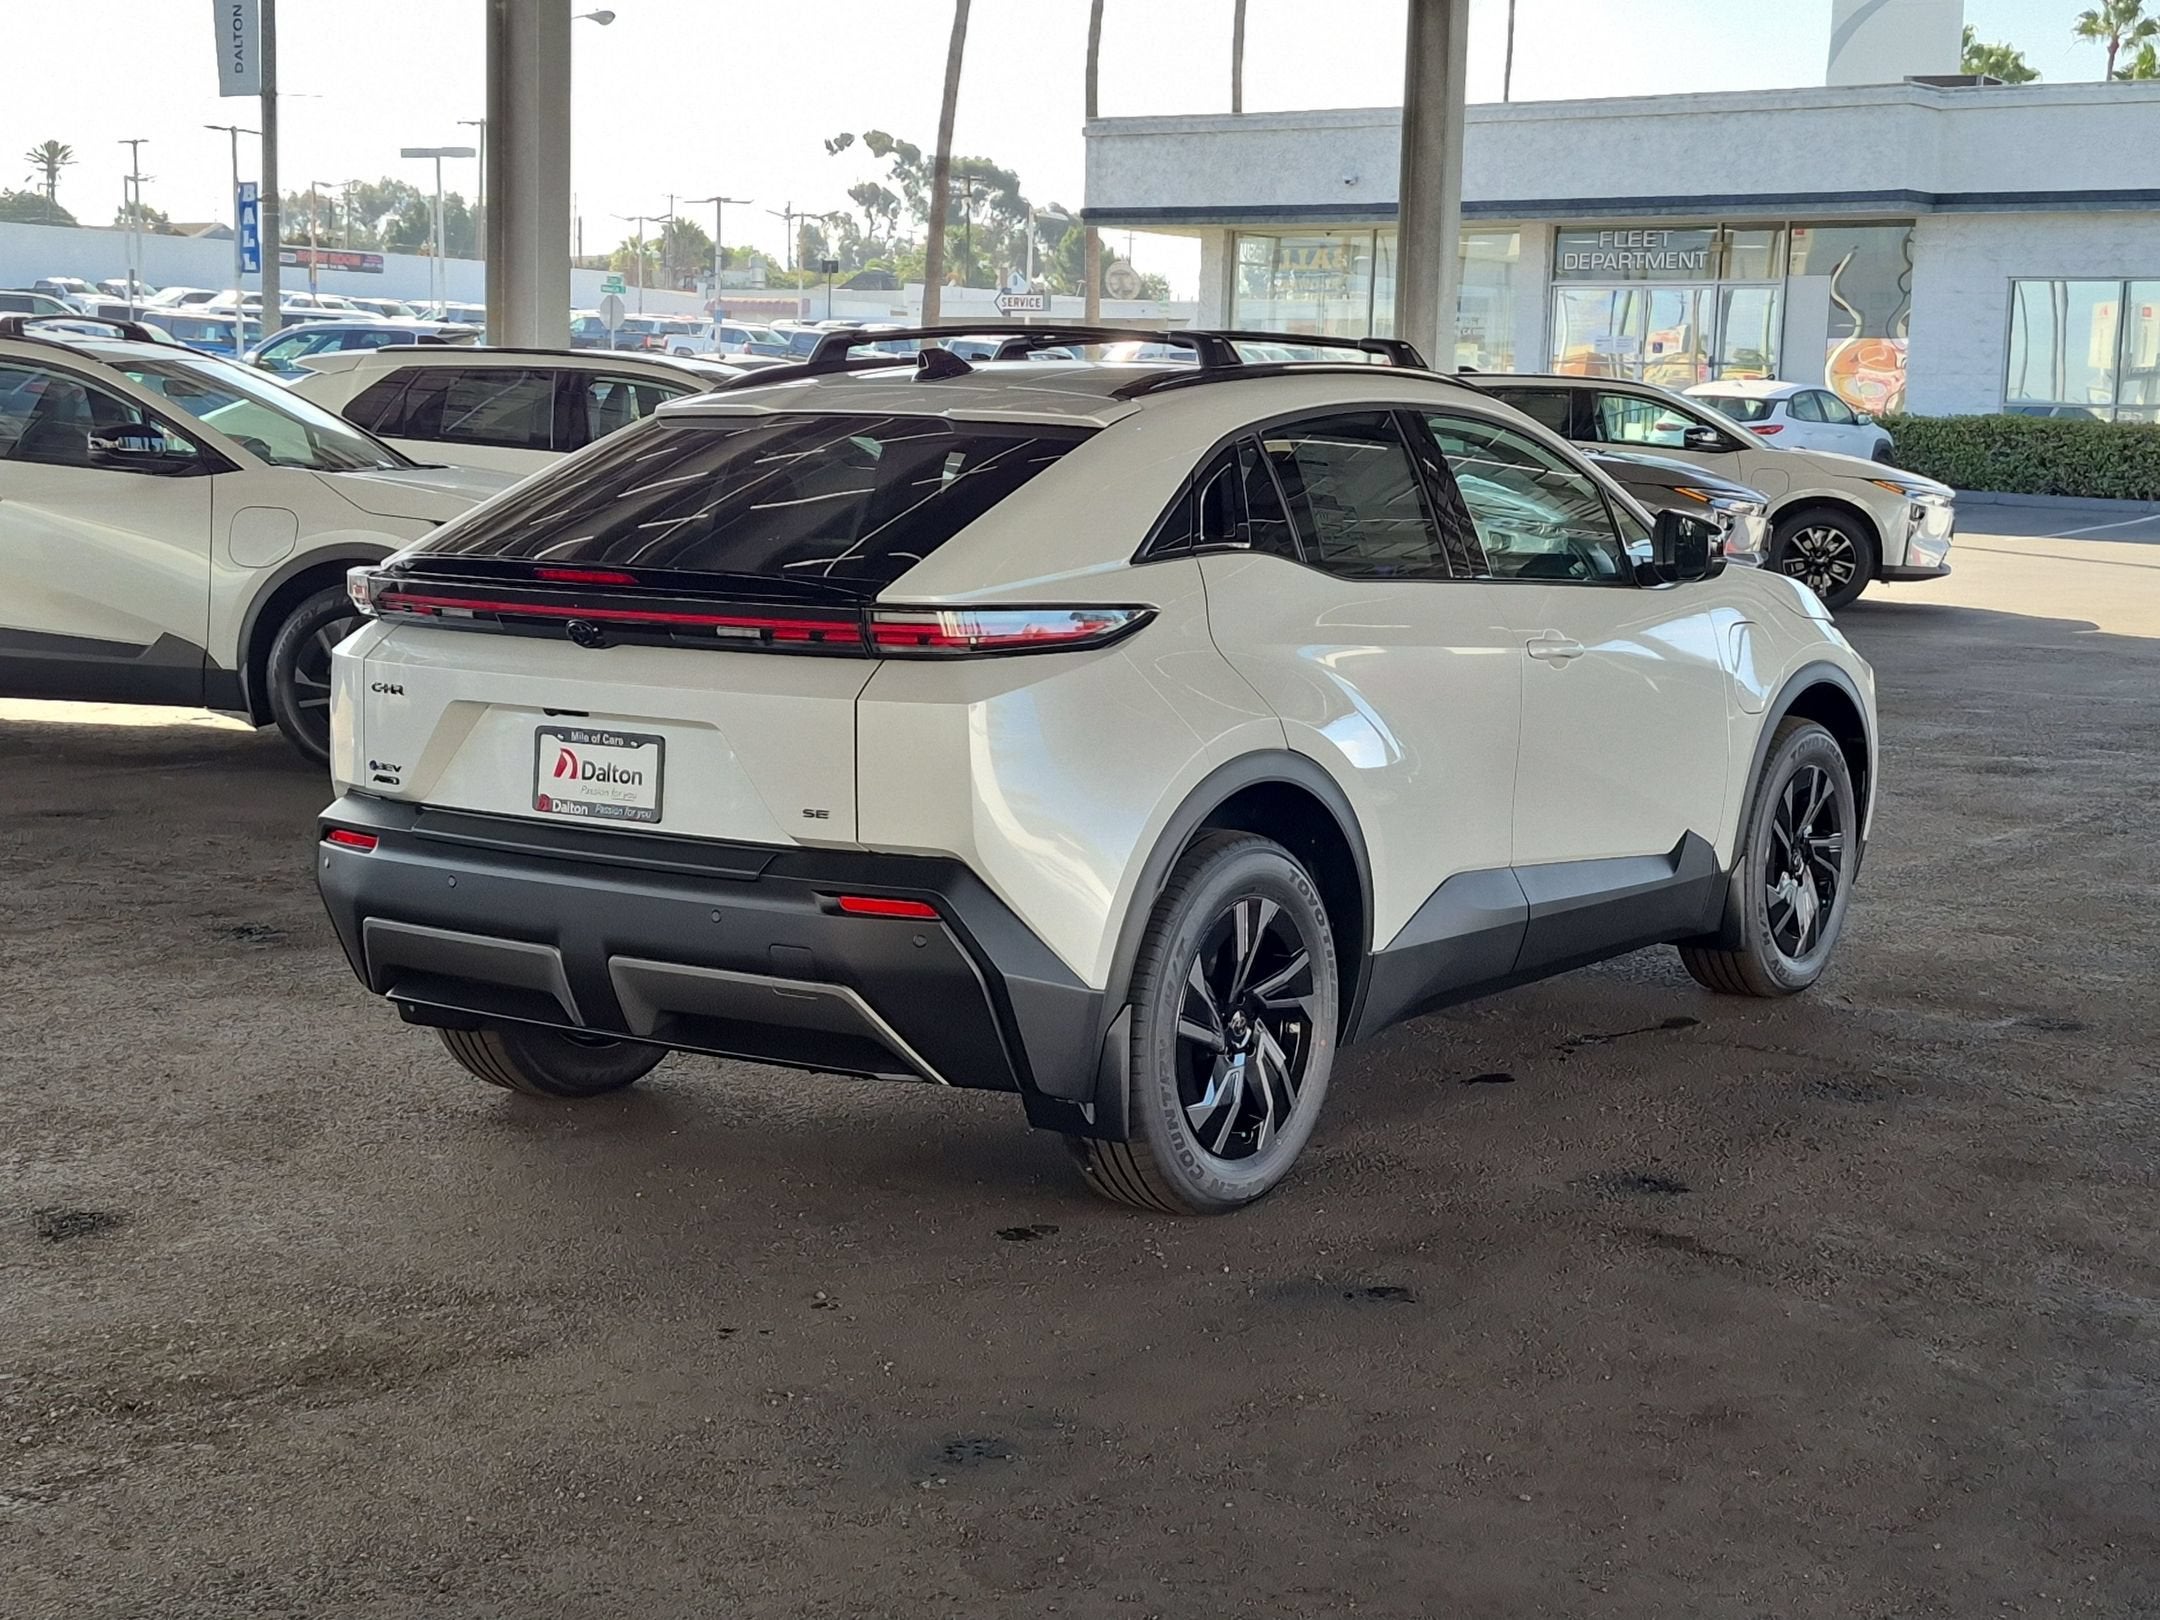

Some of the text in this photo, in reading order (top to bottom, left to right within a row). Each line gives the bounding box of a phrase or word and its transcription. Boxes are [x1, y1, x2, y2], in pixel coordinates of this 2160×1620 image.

[232, 4, 244, 73] DALTON
[242, 183, 257, 270] BALL
[1598, 230, 1674, 248] FLEET
[1563, 251, 1708, 270] DEPARTMENT
[1001, 296, 1041, 308] SERVICE
[571, 731, 624, 746] Mile of Cars
[581, 760, 643, 786] Dalton
[552, 799, 652, 820] Dalton Passion for you
[802, 808, 830, 819] SE
[1288, 867, 1326, 928] TOYO
